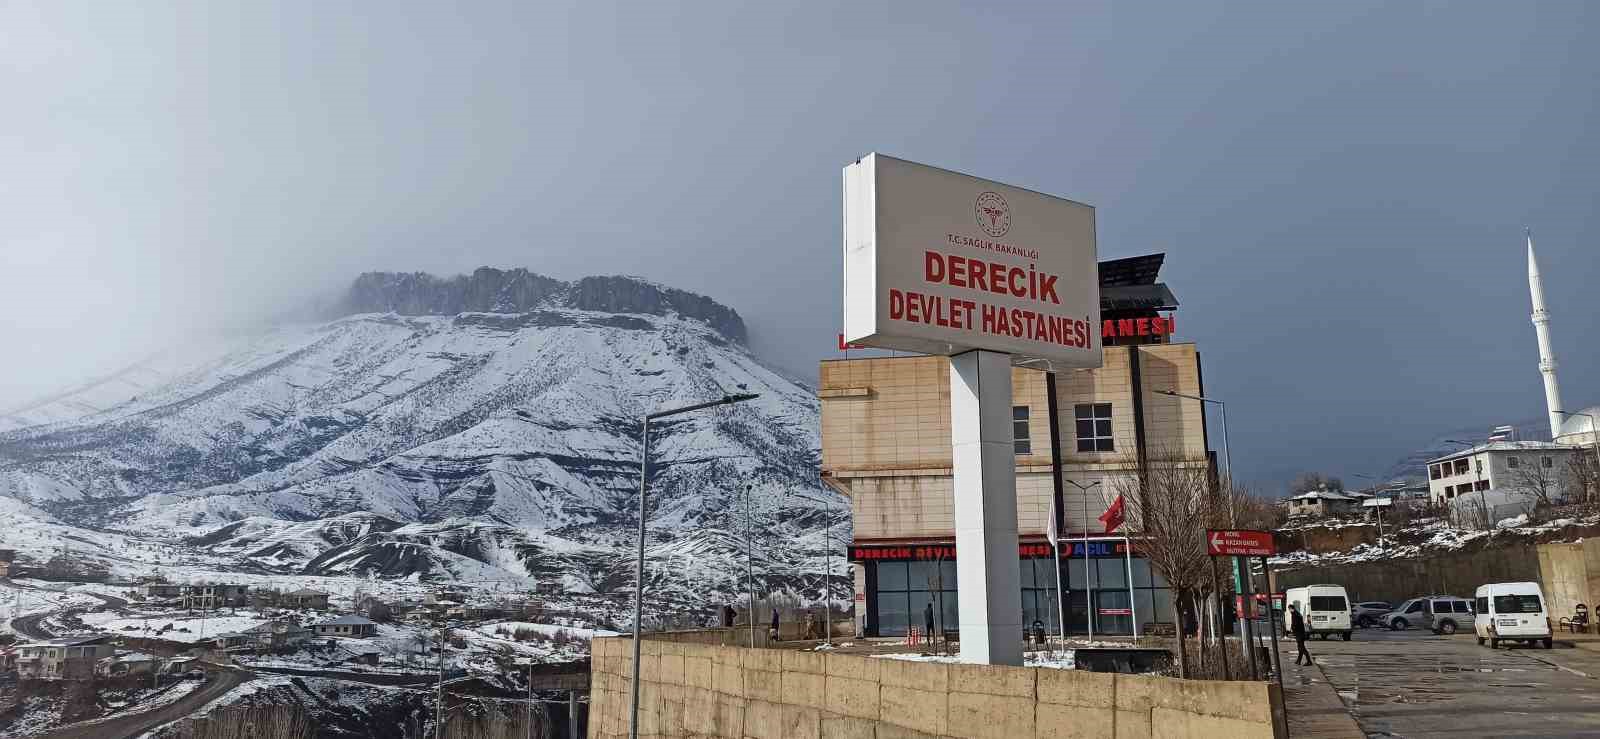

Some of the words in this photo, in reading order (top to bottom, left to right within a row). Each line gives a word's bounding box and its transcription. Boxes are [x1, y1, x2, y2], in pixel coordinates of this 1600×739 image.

[948, 234, 962, 245] T.C.
[925, 251, 1060, 304] DERECİK
[889, 288, 976, 330] DEVLET
[982, 303, 1092, 349] HASTANESİ
